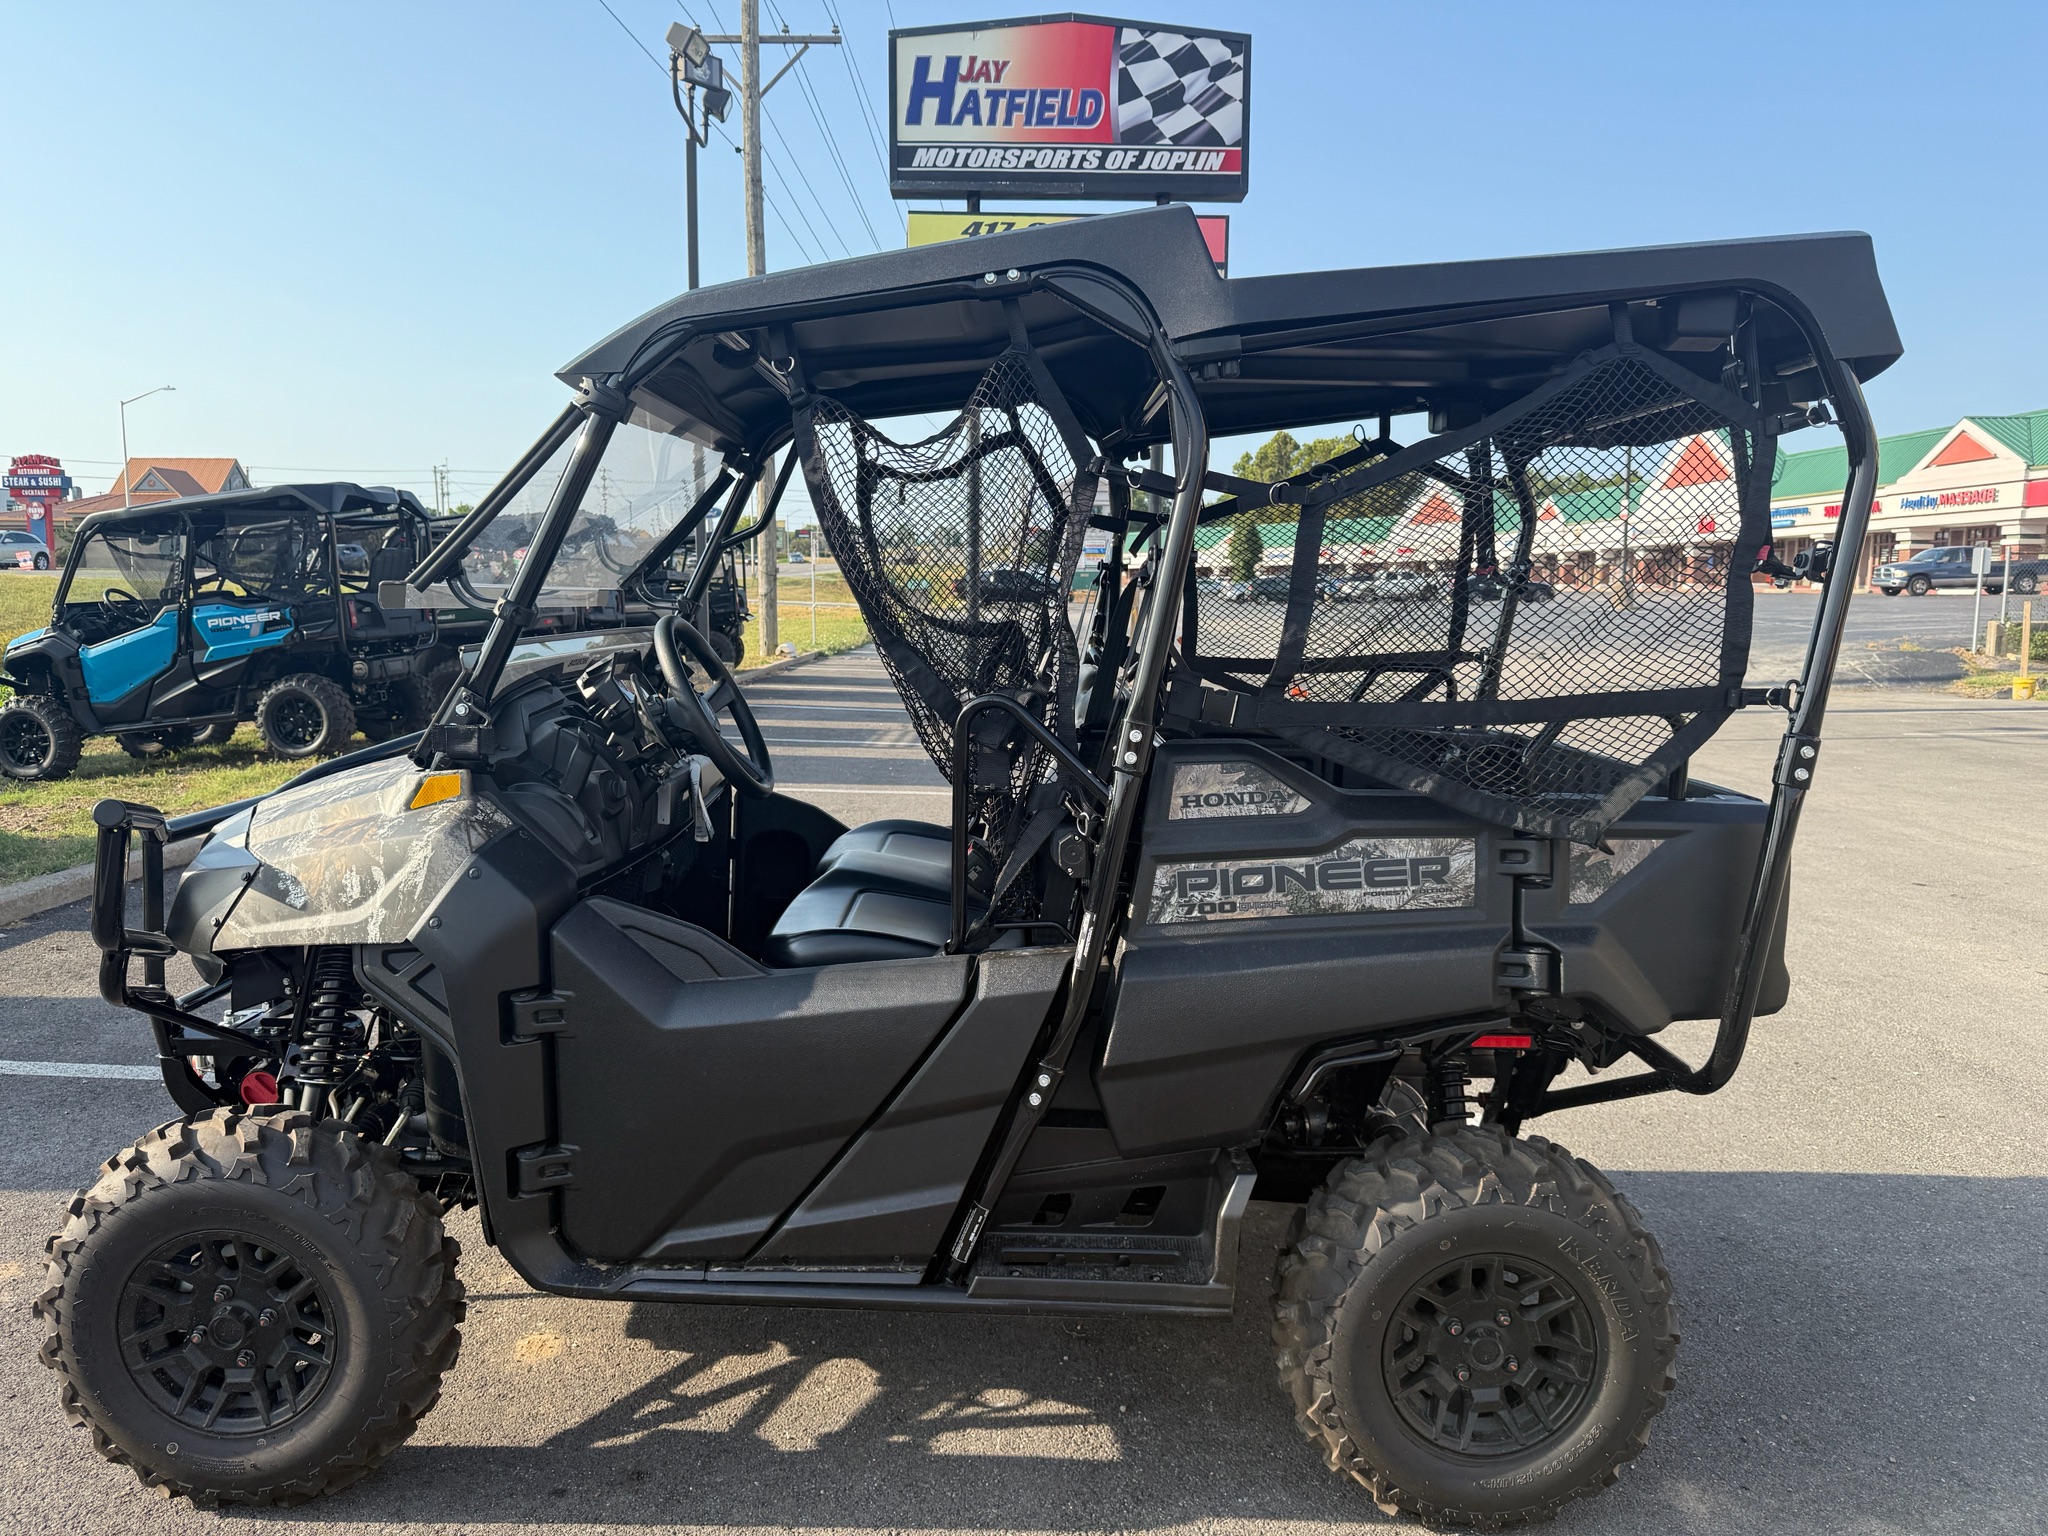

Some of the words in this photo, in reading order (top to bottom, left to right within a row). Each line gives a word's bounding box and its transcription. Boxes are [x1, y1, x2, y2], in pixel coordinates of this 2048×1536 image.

[958, 54, 1010, 83] JAY
[904, 55, 1105, 128] HATFIELD
[912, 147, 1103, 170] MOTORSPORTS
[1105, 149, 1139, 170] OF
[1138, 150, 1226, 172] JOPLIN
[11, 454, 61, 467] JAPANESE
[3, 476, 29, 487] STEAK
[30, 478, 37, 486] &
[38, 476, 62, 487] SUSHI
[1938, 488, 1998, 506] MASSAGE
[207, 611, 281, 628] PIONEER
[1180, 789, 1291, 810] HONDA
[1175, 856, 1452, 898] PIONEER
[1363, 889, 1407, 898] FOREST
[1178, 901, 1238, 916] 700
[1557, 1235, 1640, 1342] KENDA
